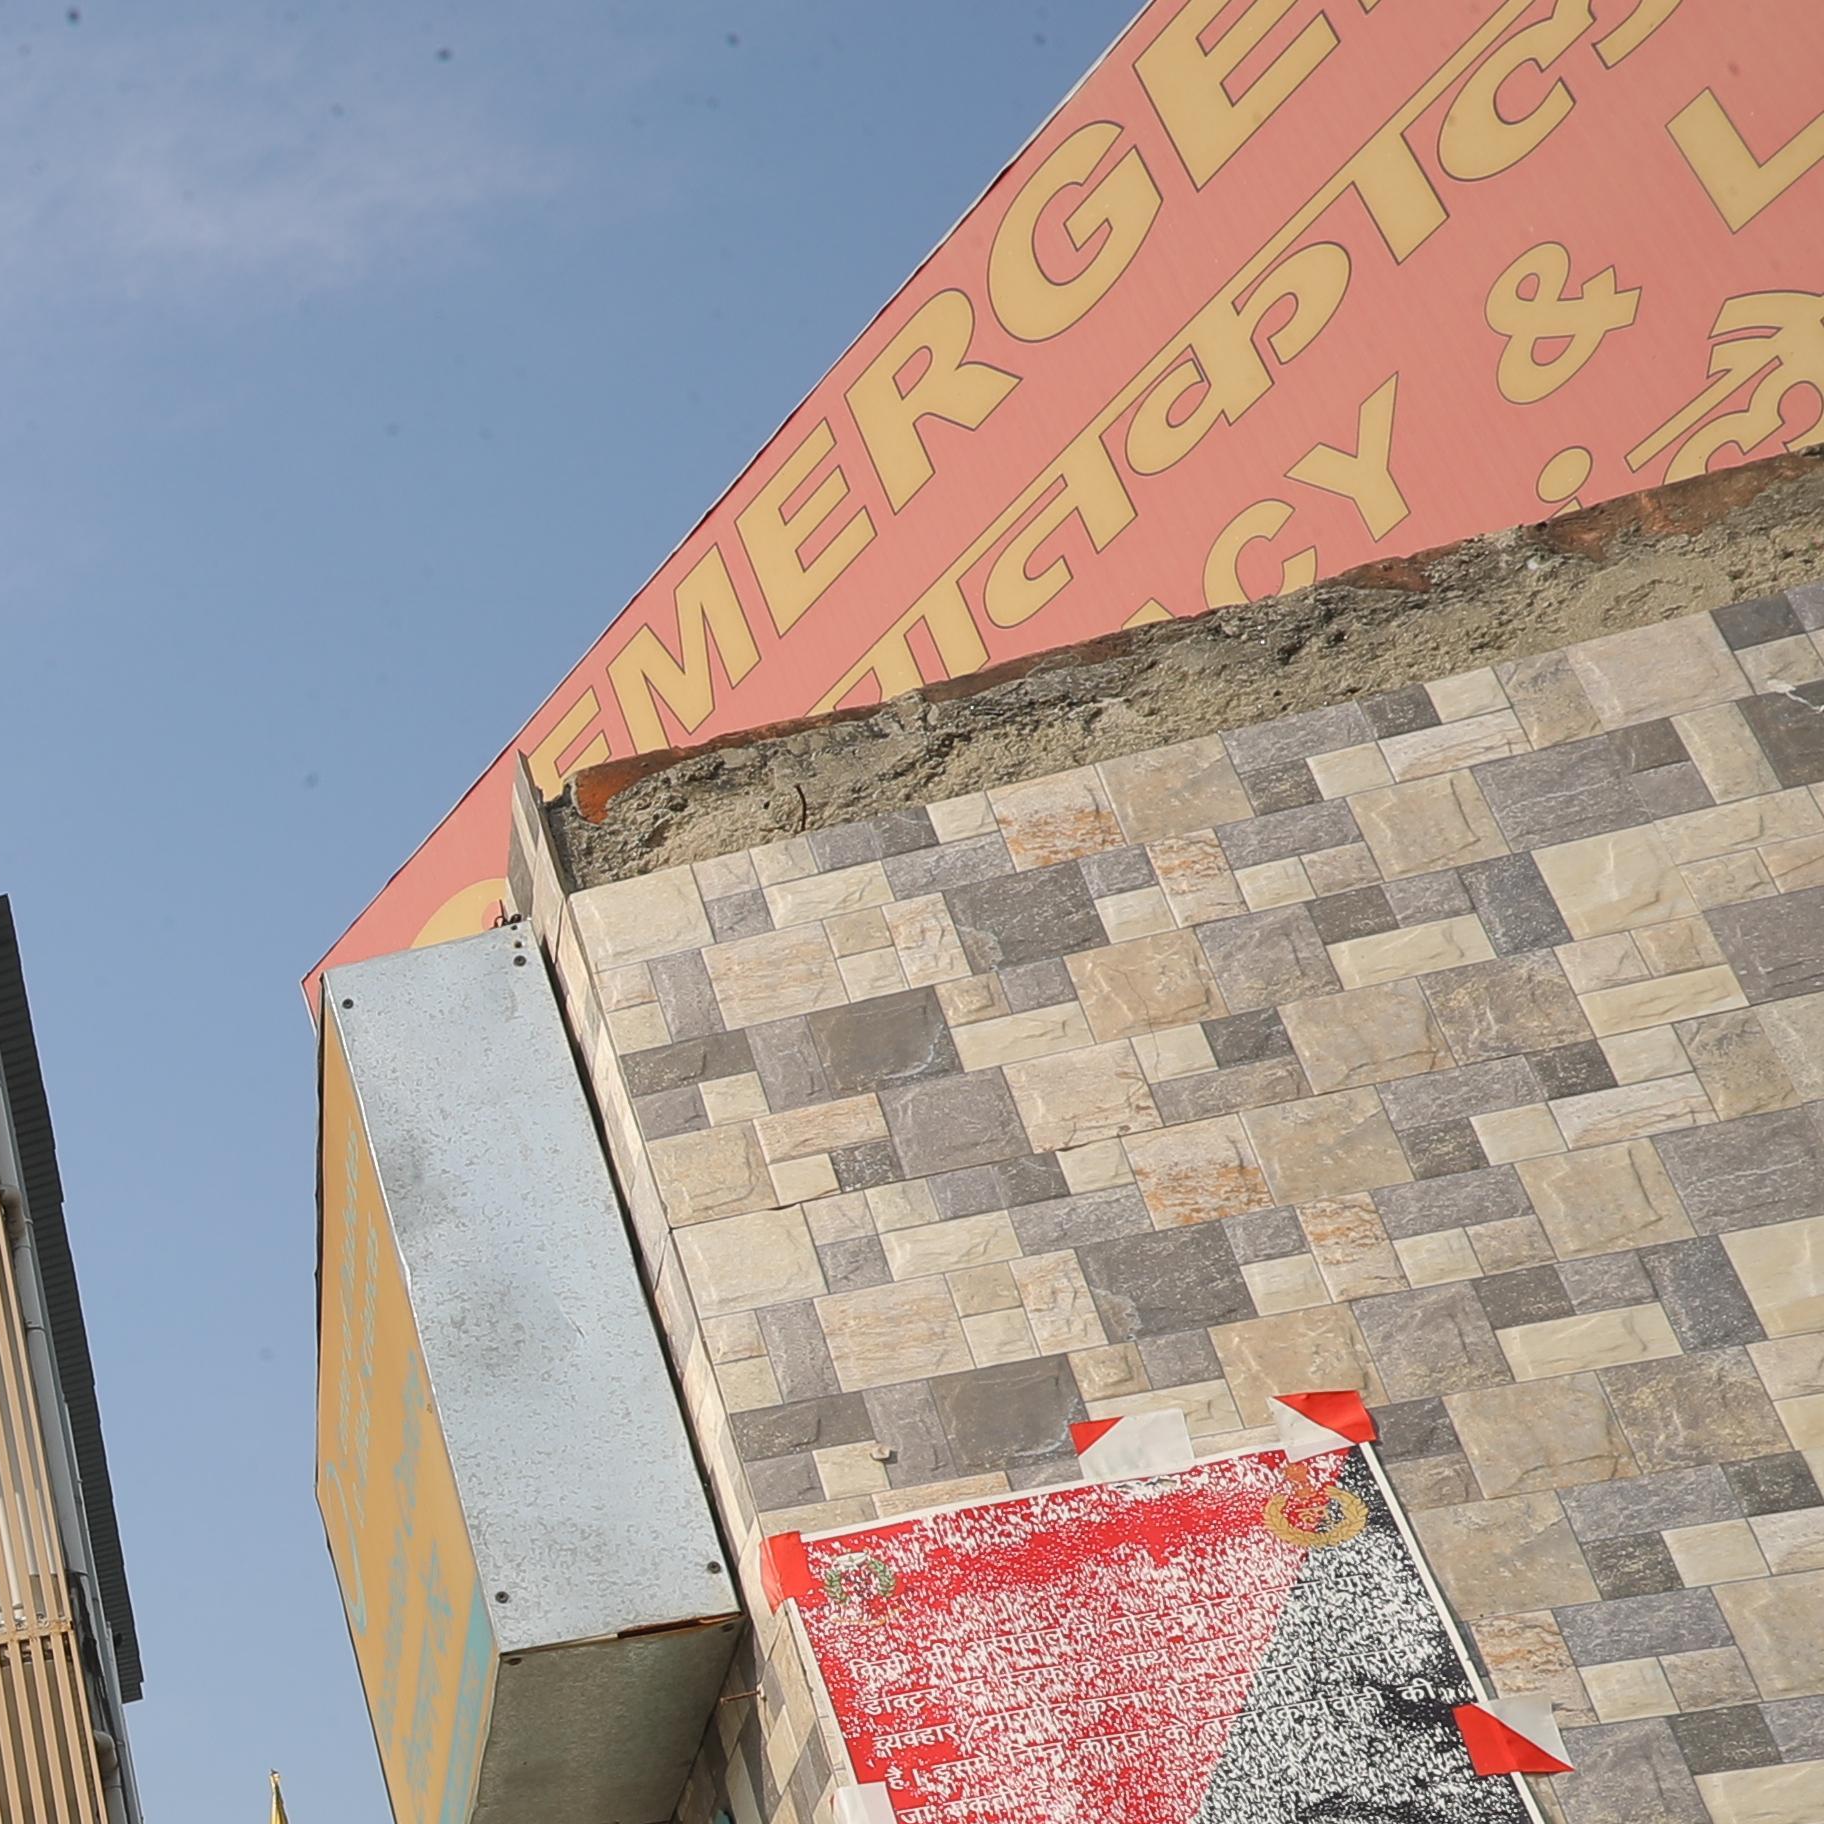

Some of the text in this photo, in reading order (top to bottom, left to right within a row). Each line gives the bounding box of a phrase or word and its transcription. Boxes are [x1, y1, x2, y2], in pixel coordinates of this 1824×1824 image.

[527, 0, 1379, 800] EMERGE
[1484, 241, 1642, 405] &
[1393, 1676, 1439, 1703] की
